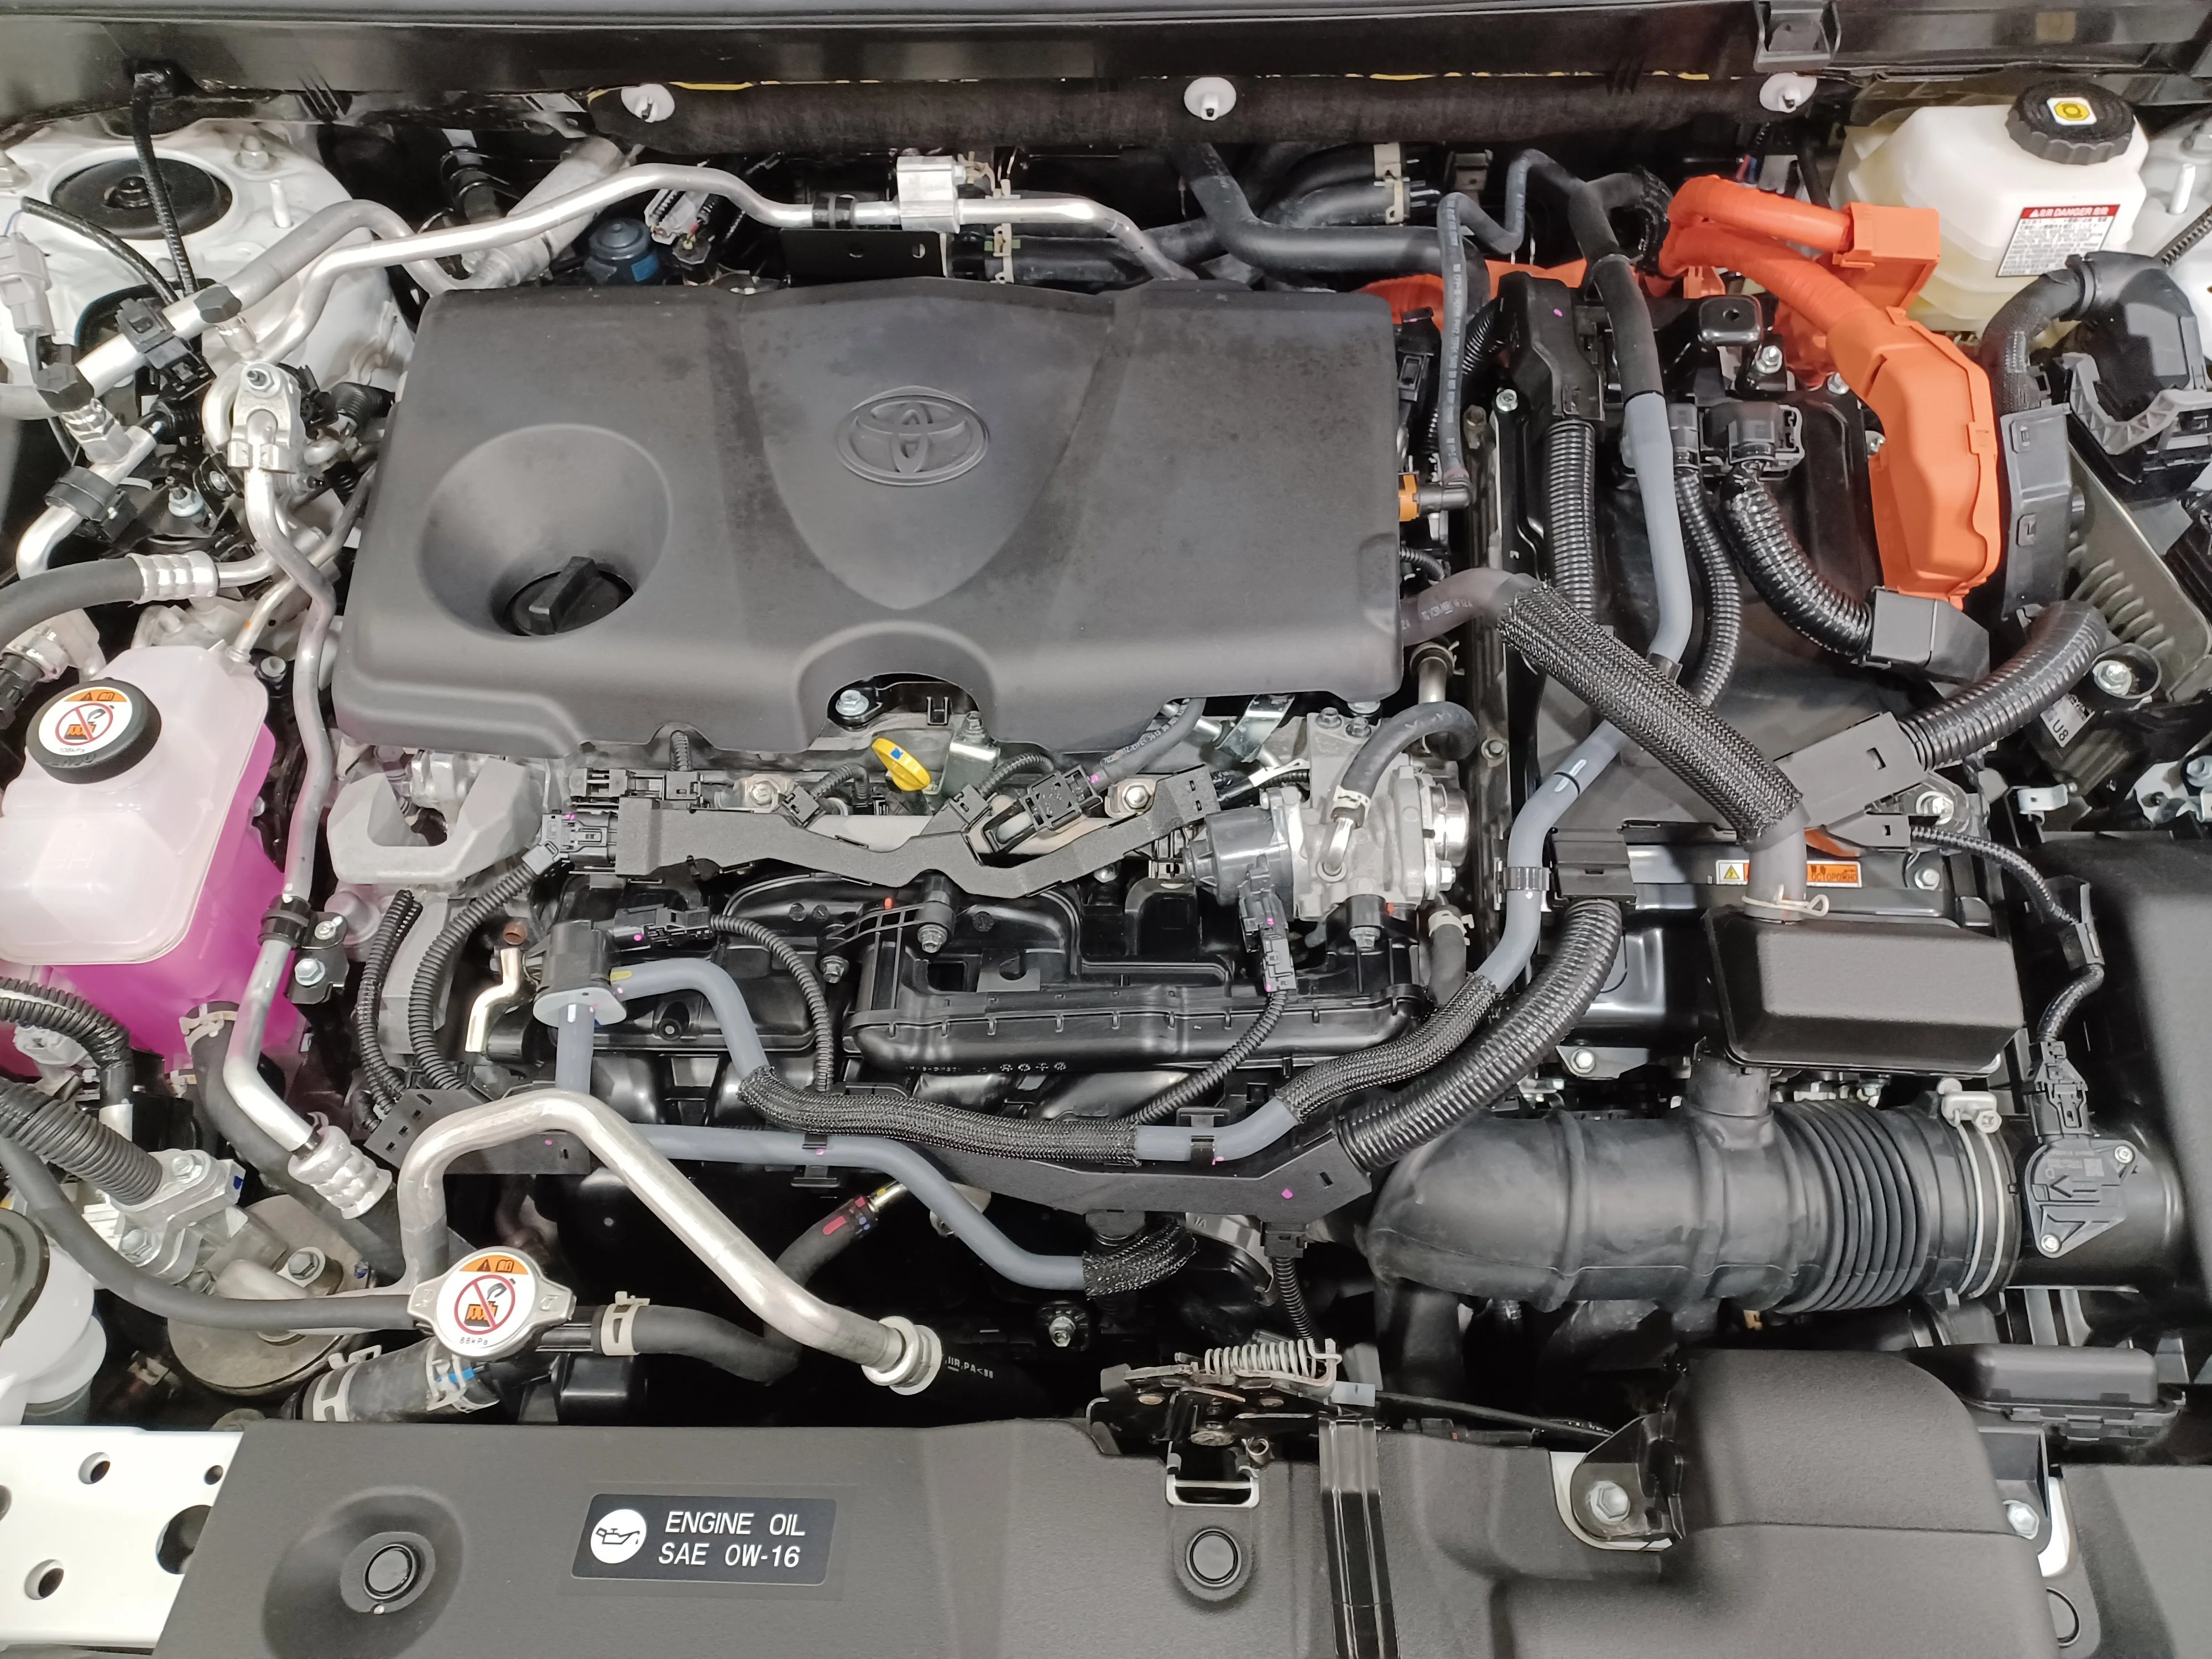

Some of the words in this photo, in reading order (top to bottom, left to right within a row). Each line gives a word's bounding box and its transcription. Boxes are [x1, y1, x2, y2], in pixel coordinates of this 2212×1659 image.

[2053, 207, 2093, 217] DANGER
[2052, 719, 2068, 741] U8
[1811, 873, 1857, 882] ОСТОРОЖНО
[460, 1337, 488, 1345] 88kPa
[665, 1511, 754, 1535] ENGINE
[769, 1514, 806, 1536] OIL
[658, 1542, 711, 1566] SAE
[724, 1543, 801, 1568] 0W-16
